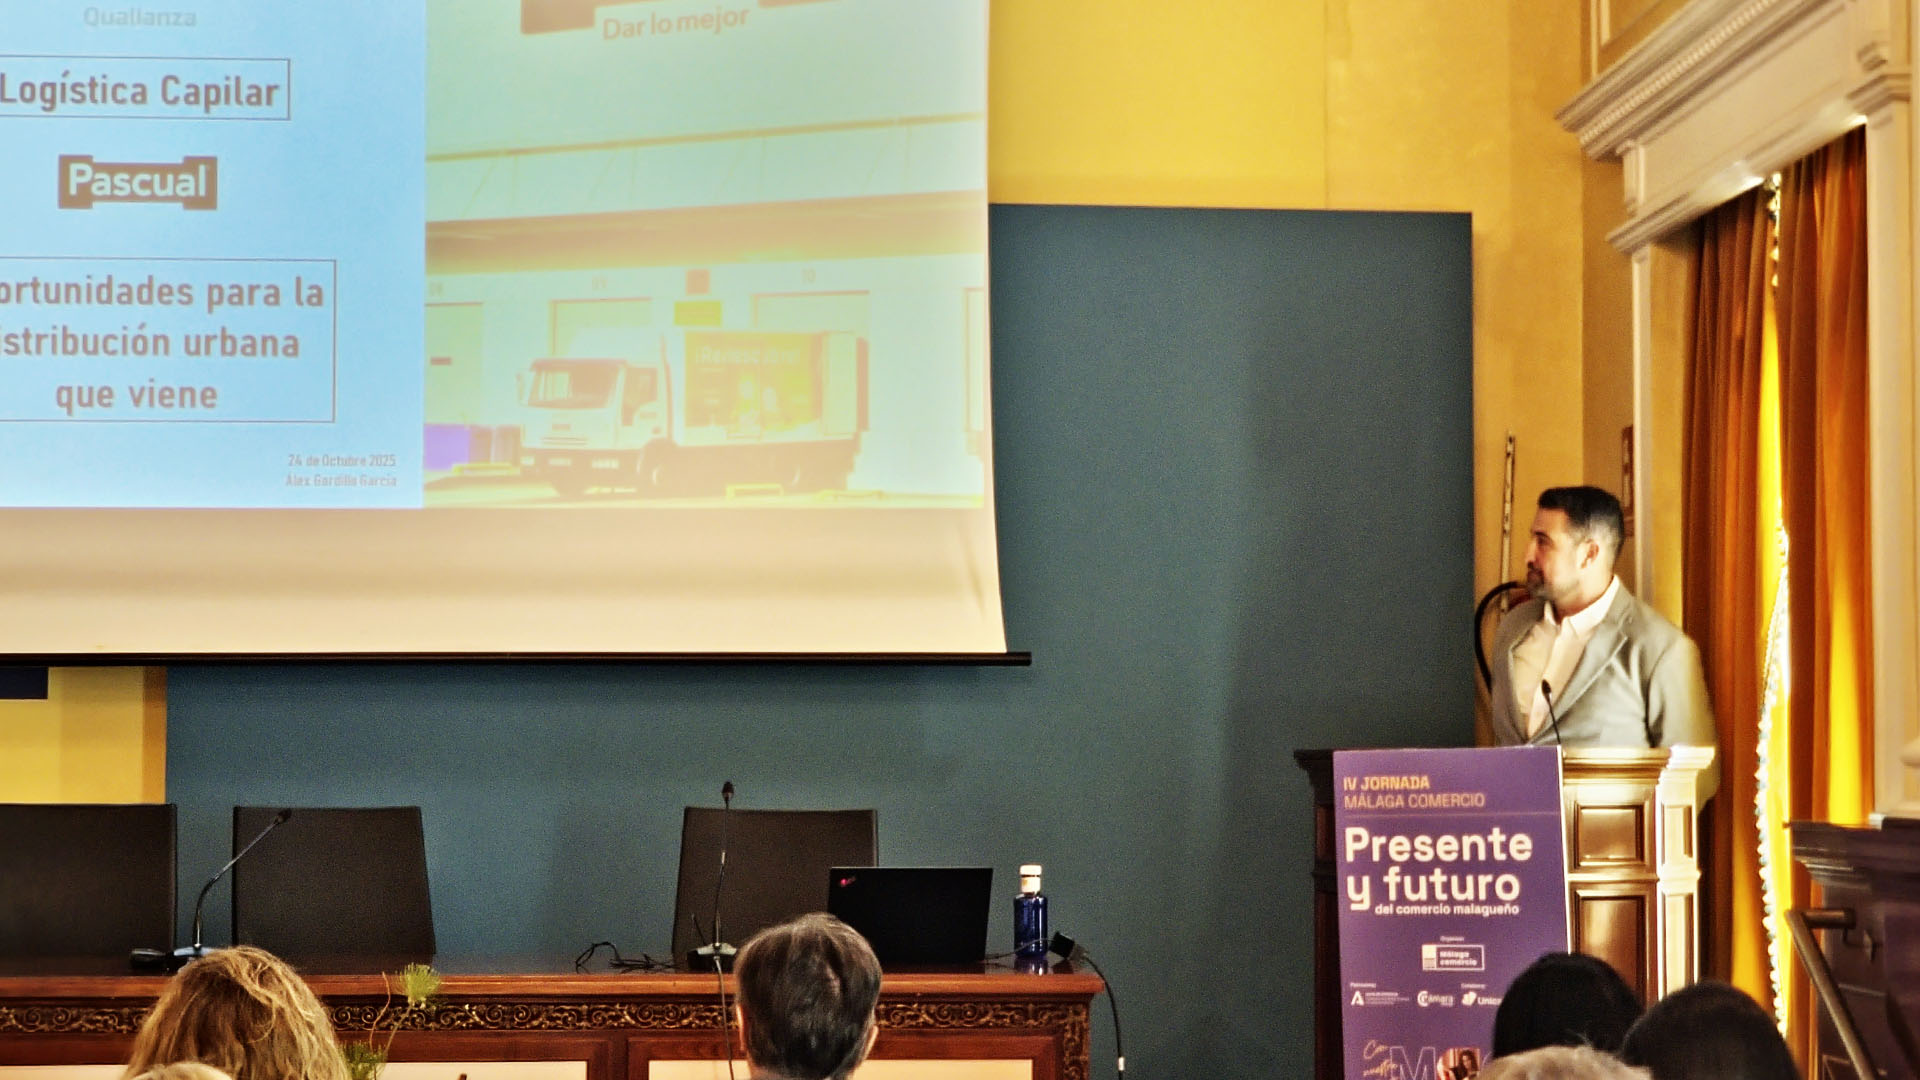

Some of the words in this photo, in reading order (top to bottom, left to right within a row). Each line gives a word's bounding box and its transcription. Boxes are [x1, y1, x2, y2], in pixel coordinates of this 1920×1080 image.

[603, 18, 645, 40] Dar
[651, 12, 673, 35] lo
[677, 6, 749, 35] mejor
[0, 70, 148, 113] Logística
[161, 75, 280, 114] Capilar
[69, 163, 206, 197] Pascual
[207, 282, 280, 314] para
[296, 276, 324, 307] la
[0, 322, 170, 356] stribución
[184, 327, 299, 358] urbana
[56, 384, 114, 416] que
[129, 378, 218, 409] viene
[306, 454, 319, 467] de
[322, 454, 366, 467] Octubre
[369, 454, 396, 467] 2025
[1343, 777, 1356, 790] IV
[1361, 775, 1430, 790] JORNADA
[1344, 793, 1404, 809] MÁLAGA
[1408, 793, 1485, 808] COMERCIO
[1345, 827, 1533, 862] Presente
[1347, 875, 1370, 911] y
[1383, 866, 1520, 902] futuro
[1375, 904, 1393, 915] del
[1396, 903, 1450, 915] comercio
[1453, 903, 1519, 917] malagueño
